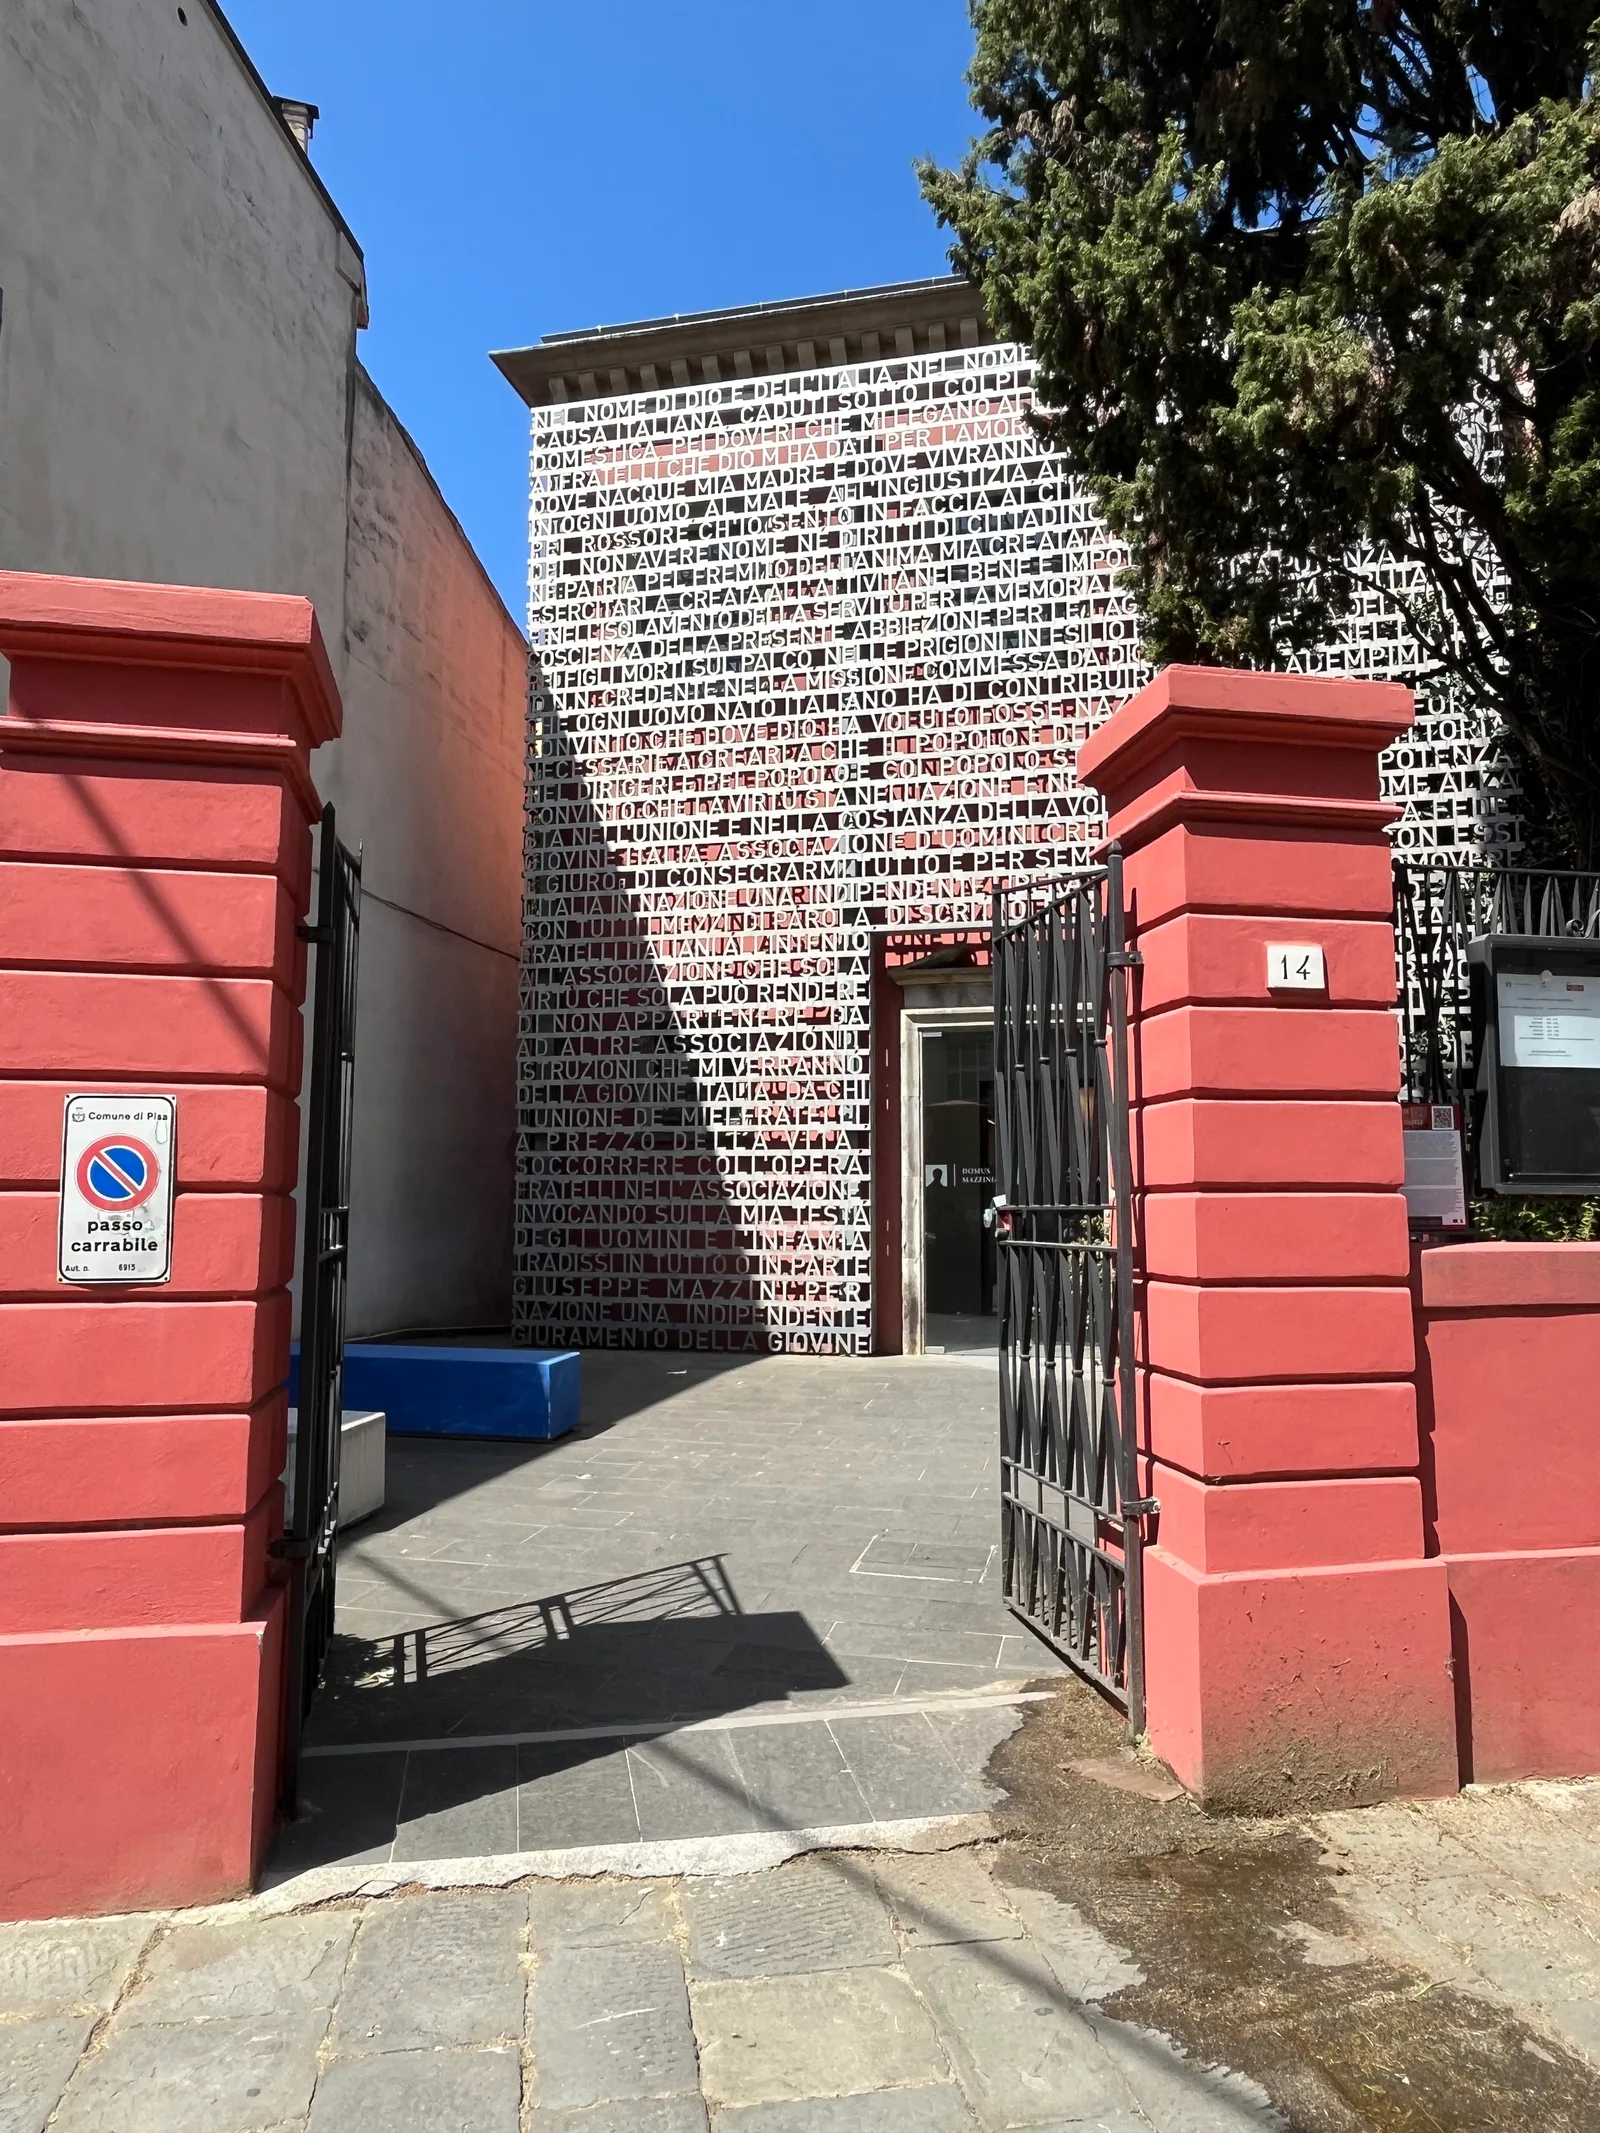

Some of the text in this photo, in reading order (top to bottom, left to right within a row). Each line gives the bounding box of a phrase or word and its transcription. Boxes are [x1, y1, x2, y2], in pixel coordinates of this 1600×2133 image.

[583, 343, 1032, 423] NOME DI DIO NOME
[532, 369, 1019, 451] CAUSA CADUTI SOTTO COLPI
[672, 397, 989, 455] PEI DOVERI CHE MI LEGANO
[562, 426, 930, 490] FRATELLI CHE DIO DATI PER
[534, 435, 1055, 515] DOVE NACQUE MIA MADRE DOVE VIVRANNO
[561, 497, 734, 534] OGNI AL
[581, 484, 1028, 553] ROSSORE SENTO IN FACCIA AI
[580, 517, 955, 575] NON AVERE NOME DIRITTI DI
[645, 527, 1084, 591] PEL FREMITO MIA CREATA
[678, 556, 1033, 610] CREATA NEL BENE
[740, 573, 1106, 627] DELLA PER LA MEMORIA
[651, 634, 720, 658] DELLA
[728, 622, 844, 651] PRESENTE
[997, 603, 1043, 626] PER
[1053, 600, 1079, 621] LE
[564, 627, 1041, 688] FIGLI MORTI SUL NELLE IN
[601, 647, 1098, 707] CREDENTE NELLA MISSIONE COMMESSA DA
[575, 710, 629, 731] OGNI
[638, 704, 704, 726] UOMO
[716, 698, 775, 720] NATO
[909, 684, 942, 705] HA
[952, 681, 975, 702] DI
[649, 699, 1061, 749] CHE DOVE DIO HA VOLUTO FOSSE
[821, 738, 869, 760] CHE
[916, 727, 1019, 753] POPOLO
[708, 770, 748, 791] PEL
[754, 763, 850, 788] POPOLO
[882, 757, 931, 779] COL
[941, 750, 1041, 775] POPOLO
[641, 787, 852, 819] CHE LA STA
[749, 812, 827, 835] NELLA
[839, 803, 972, 830] COSTANZA
[978, 798, 1059, 822] DELLA
[719, 831, 906, 861] ASSOCIAZIONE
[633, 849, 1024, 888] DI TUTTO PER
[610, 889, 738, 913] IN NAZIONE
[744, 959, 787, 979] CHE
[798, 956, 865, 977] SOLA
[1280, 954, 1311, 981] 14
[587, 988, 628, 1007] CHE
[637, 985, 699, 1006] SOLA
[757, 980, 866, 1002] RENDERE
[518, 1012, 602, 1033] DI NON
[516, 1035, 642, 1057] AD ALTRE
[517, 1055, 863, 1080] ISTRUZIONI CHE MI VERRANNO
[595, 1082, 686, 1103] GIOVINE
[788, 1080, 817, 1100] DA
[825, 1079, 866, 1100] CHI
[88, 1112, 168, 1121] Comune di Pisa
[548, 1130, 770, 1151] PREZZO DELLA
[516, 1155, 684, 1175] SOCCORRERE
[87, 1220, 143, 1234] passo
[515, 1203, 783, 1226] INVOCANDO SULLA MIA
[71, 1237, 158, 1252] carrabile
[514, 1227, 690, 1249] DEGLI UOMINI
[514, 1252, 868, 1277] TRADISSI IN TUTTO IN PARTE
[513, 1275, 861, 1303] GIUSEPPE PER
[513, 1300, 611, 1322] NAZIONE
[512, 1324, 870, 1355] GIURAMENTO DELLA GIOVINE
